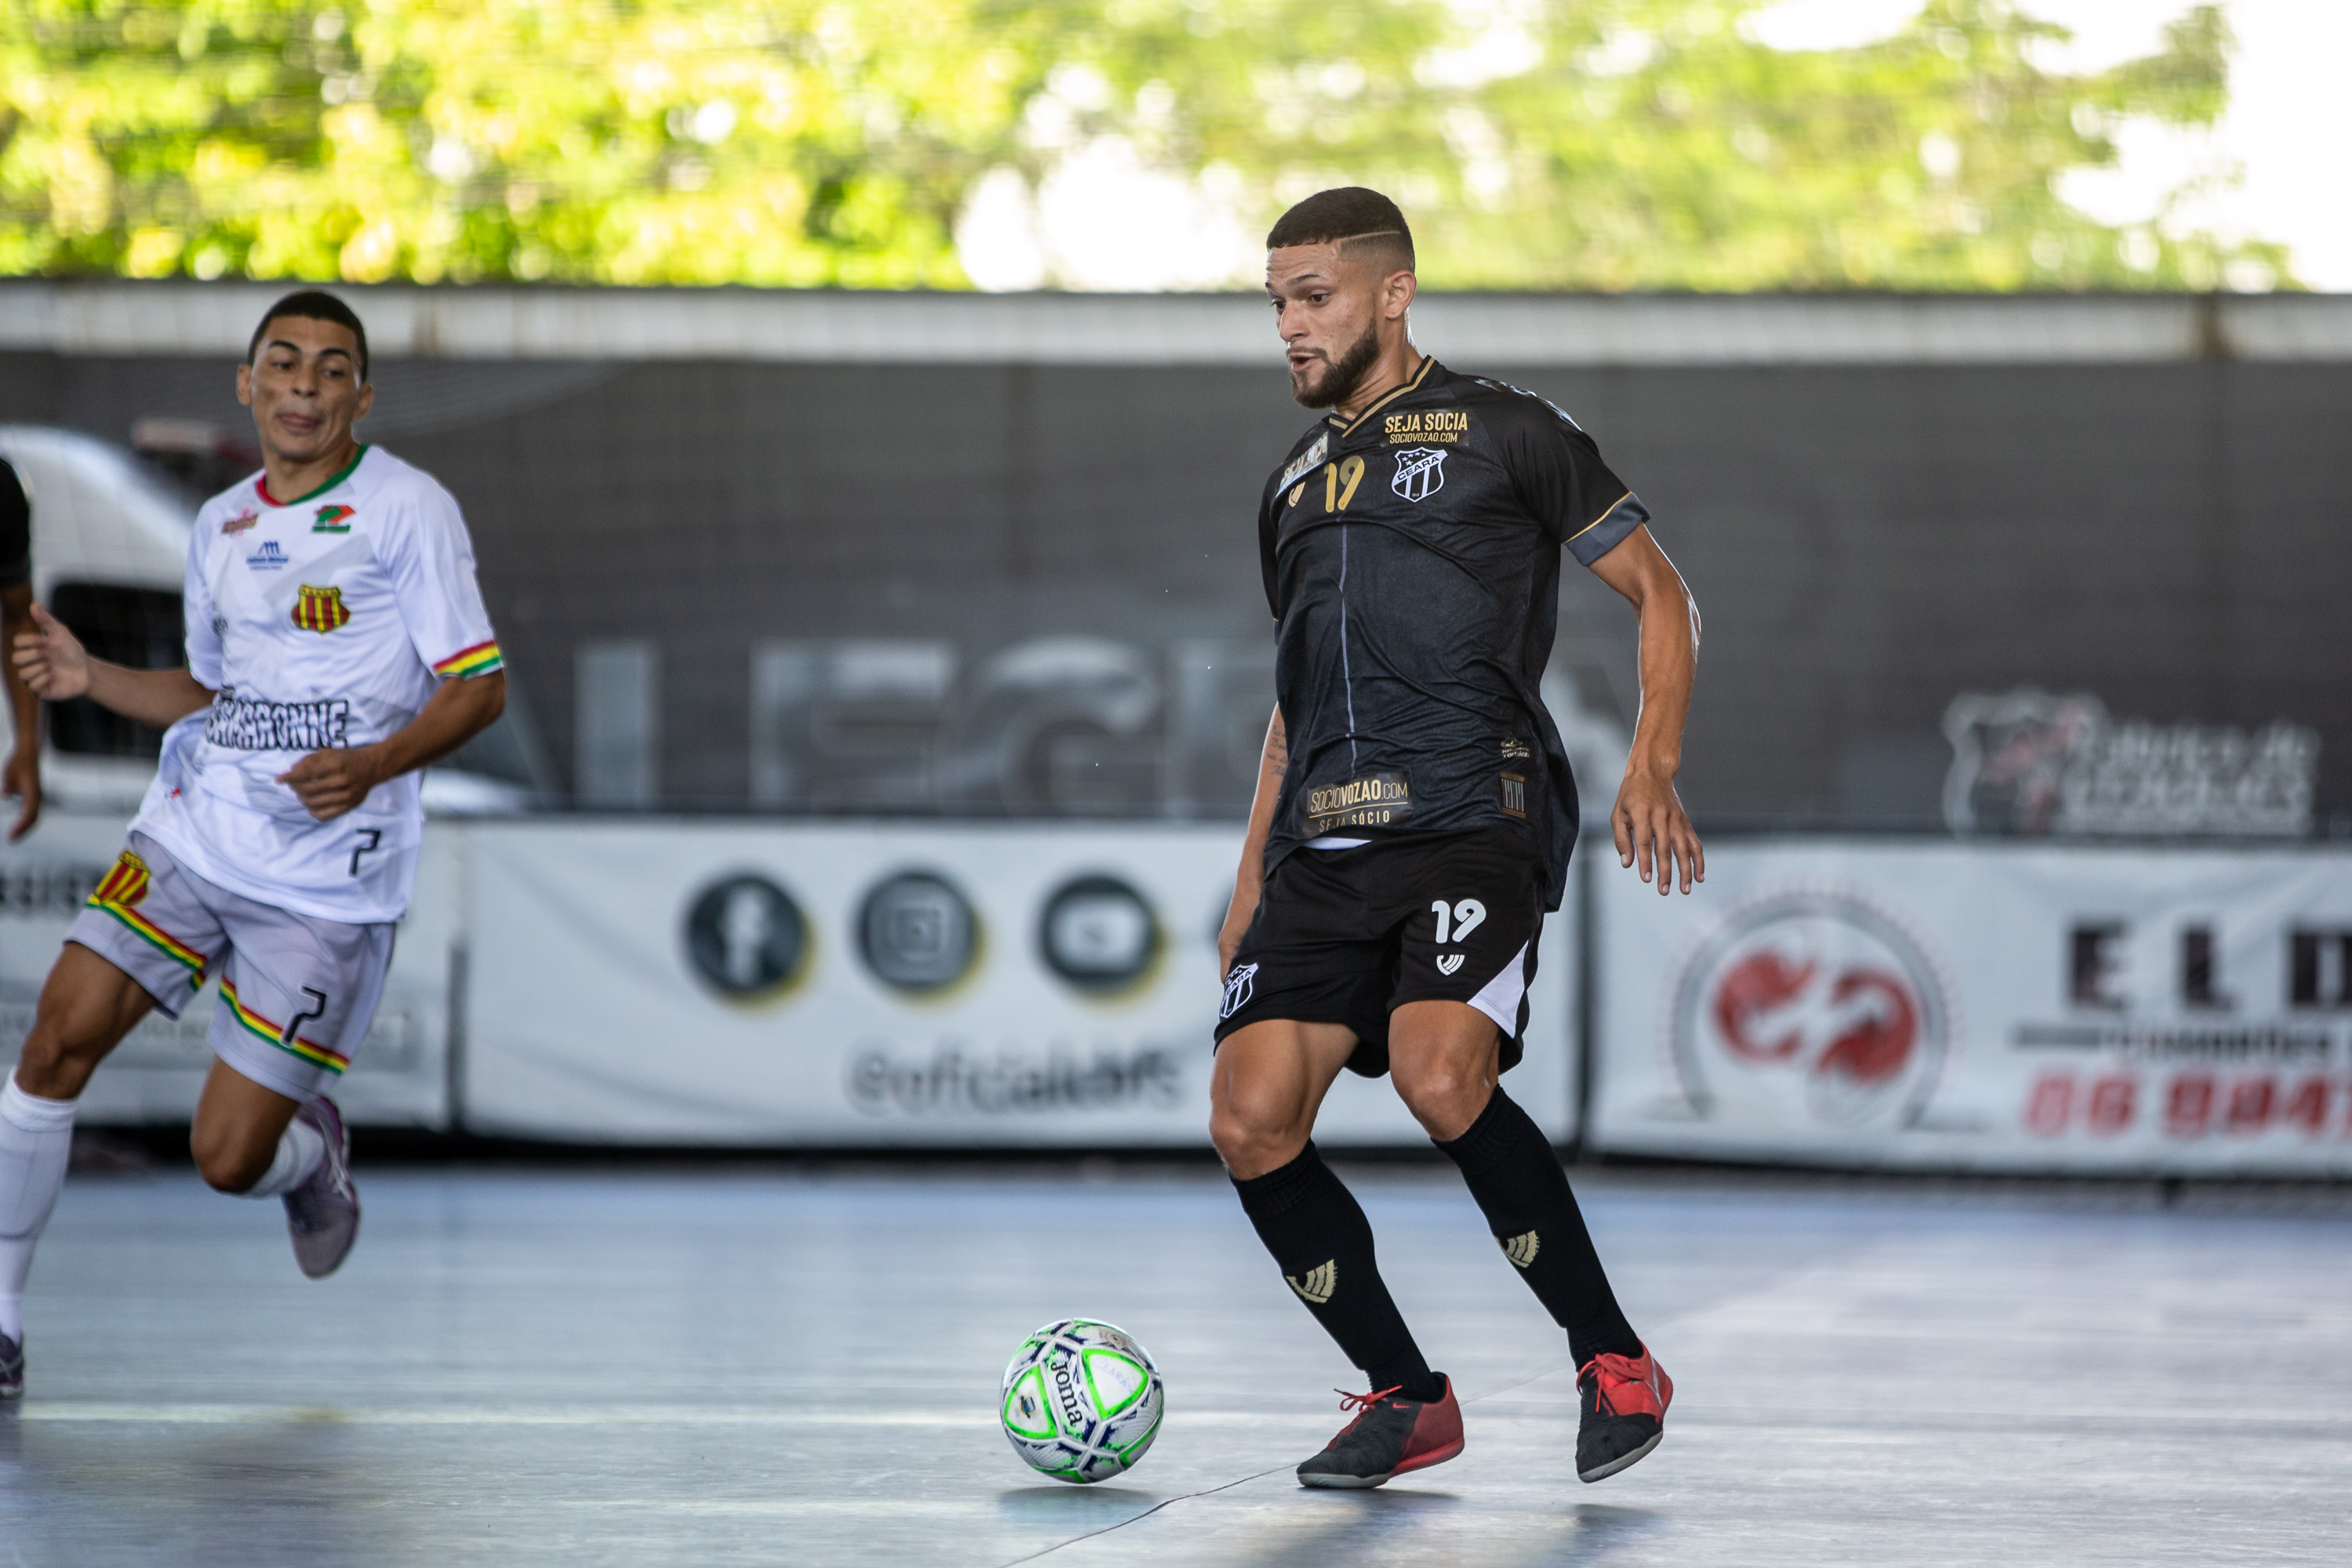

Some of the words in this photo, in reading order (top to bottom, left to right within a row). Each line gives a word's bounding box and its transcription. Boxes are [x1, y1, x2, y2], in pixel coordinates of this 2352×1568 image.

[1385, 414, 1421, 434] SEJA
[1425, 412, 1468, 431] SOCIA
[1389, 432, 1458, 444] SOCIOVOZAO.COM
[1323, 455, 1365, 514] 19
[1397, 454, 1439, 481] CEARÁ
[1310, 779, 1408, 813] SOCIOVOZAO.COM
[1351, 810, 1390, 826] SÓCIO
[350, 829, 381, 877] 7
[1432, 898, 1486, 944] 19
[280, 985, 327, 1047] 7
[1051, 1361, 1083, 1427] Joma
